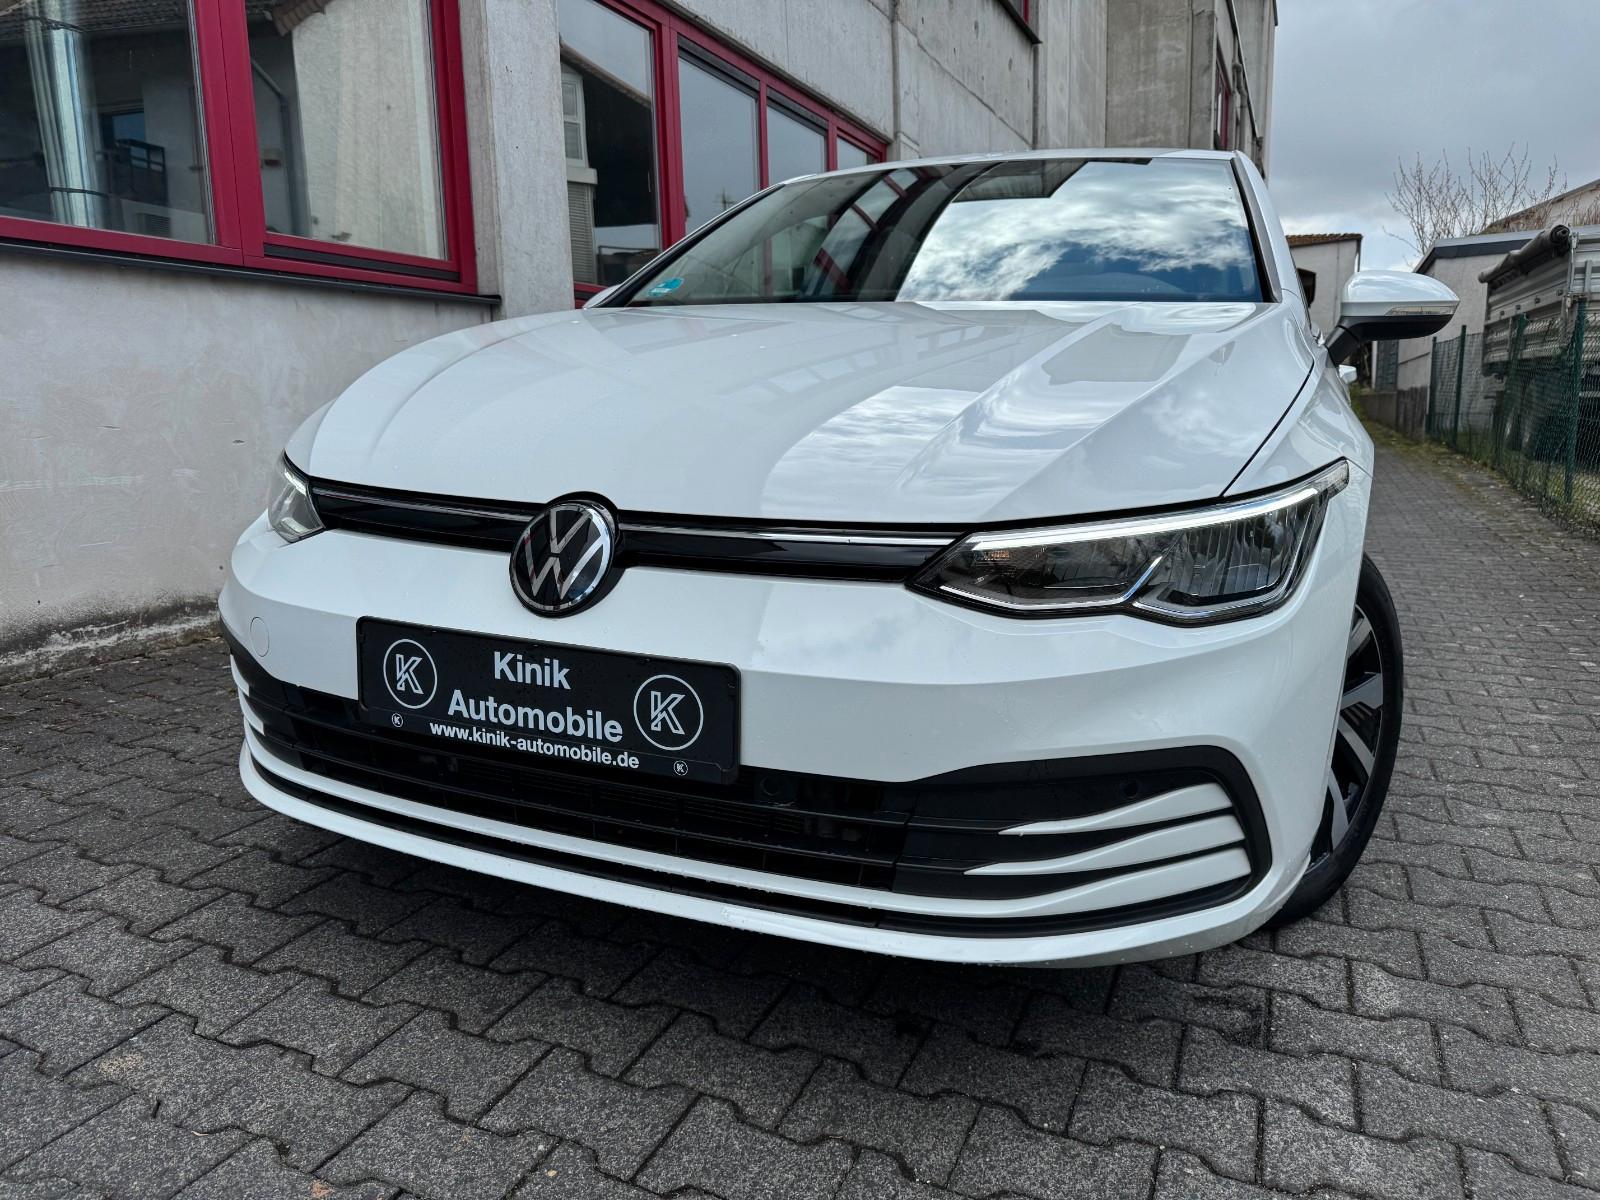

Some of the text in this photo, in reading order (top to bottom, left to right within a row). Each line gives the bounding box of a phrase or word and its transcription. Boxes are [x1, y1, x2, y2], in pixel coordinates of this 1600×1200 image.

[395, 653, 425, 695] K
[493, 651, 572, 690] Kinik
[447, 689, 624, 743] Automobile
[650, 690, 686, 735] K
[429, 722, 640, 769] www.kinik-automobile.de
